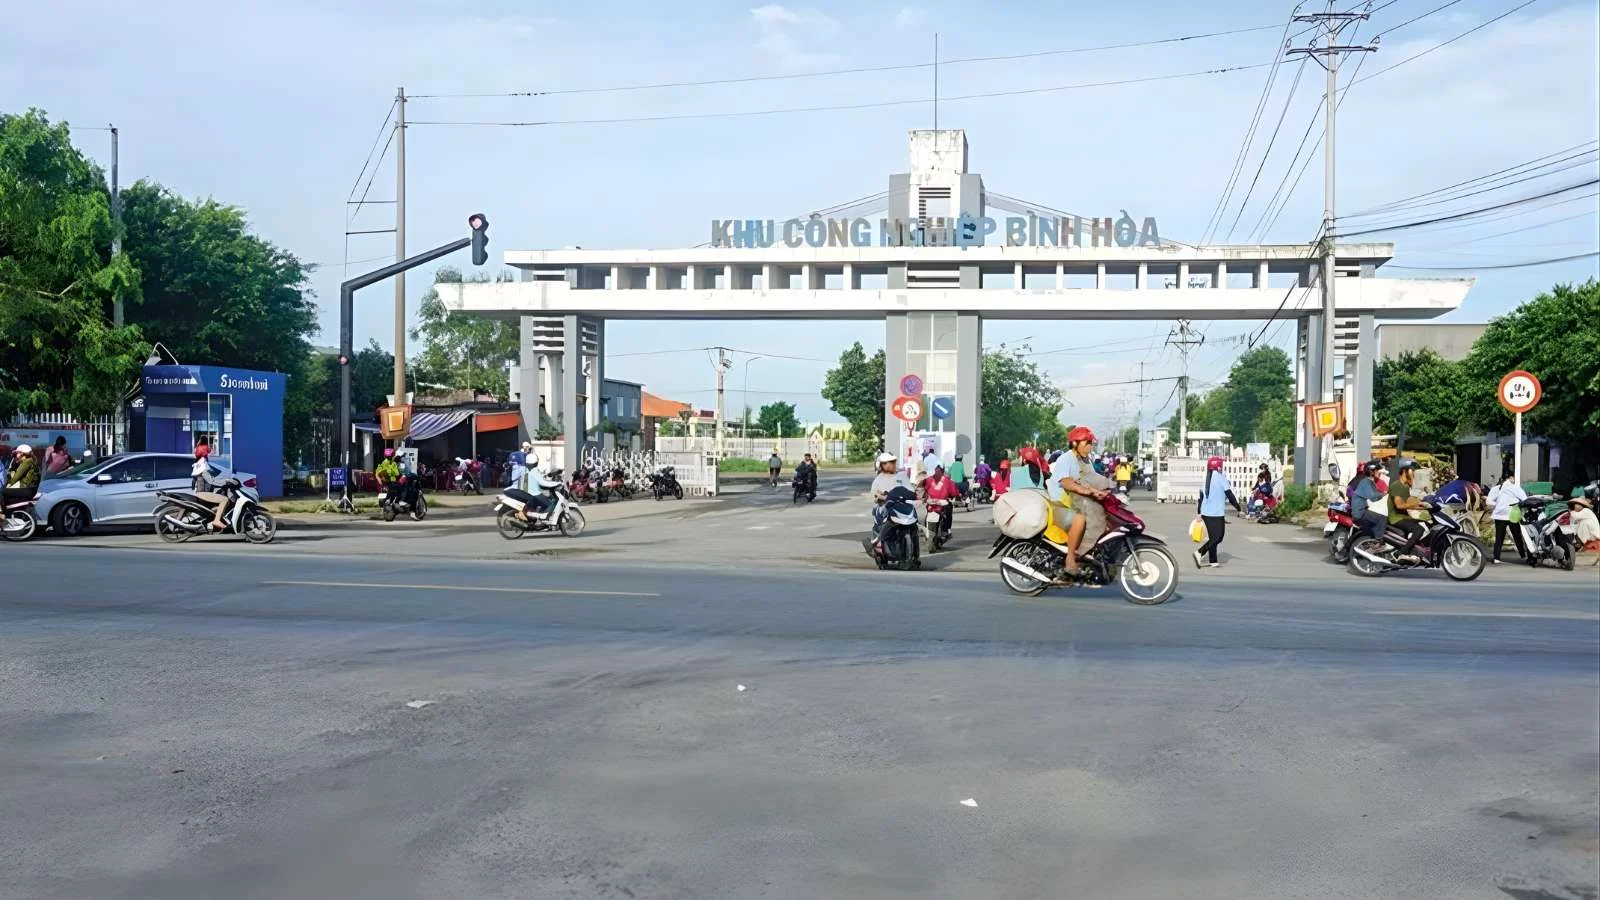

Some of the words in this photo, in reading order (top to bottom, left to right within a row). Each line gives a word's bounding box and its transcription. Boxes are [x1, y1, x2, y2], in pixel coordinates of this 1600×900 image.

[711, 218, 775, 248] KHU
[783, 212, 871, 248] CÔNG
[1006, 209, 1082, 247] BÌNH
[1091, 208, 1161, 247] HÒA
